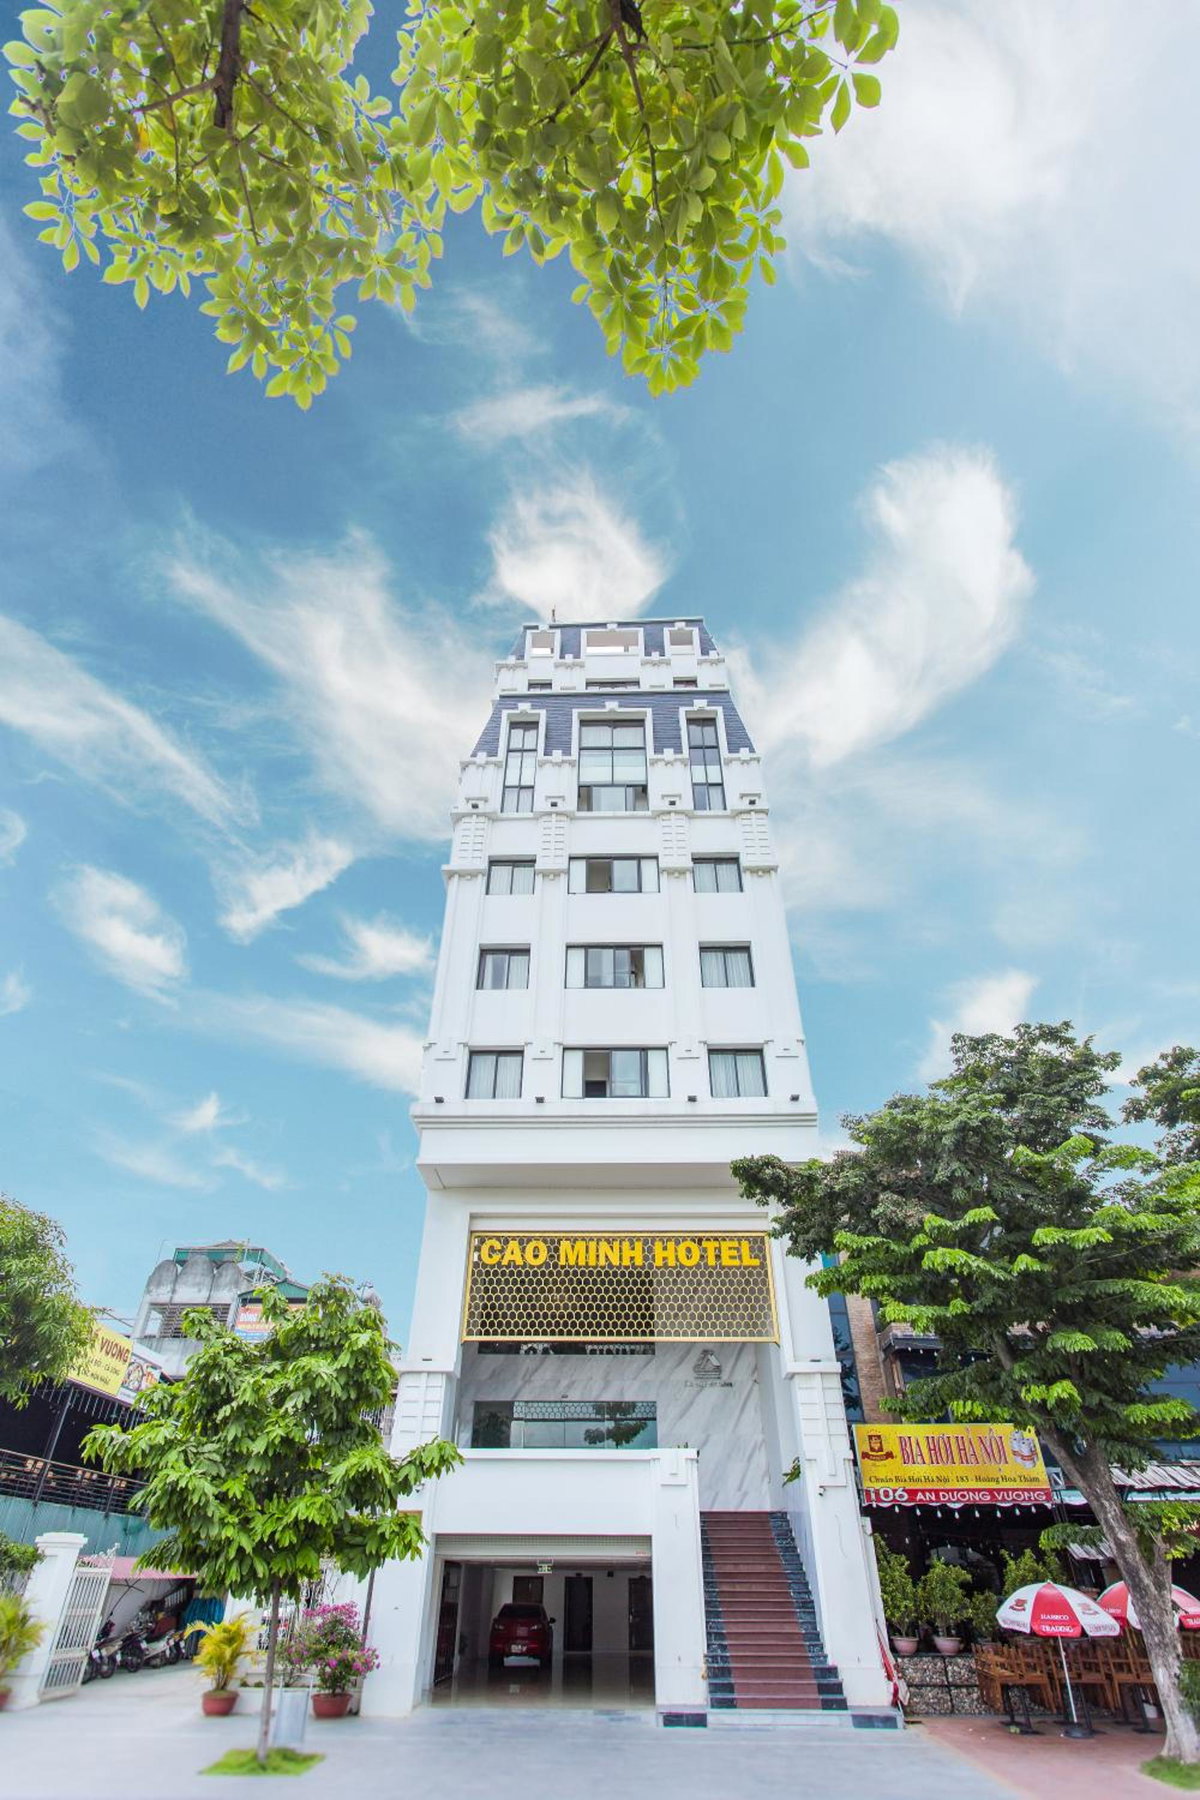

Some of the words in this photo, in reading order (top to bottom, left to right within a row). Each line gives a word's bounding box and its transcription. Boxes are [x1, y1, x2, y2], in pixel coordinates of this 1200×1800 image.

[480, 1239, 548, 1266] CAO
[560, 1240, 643, 1266] MINH
[654, 1240, 760, 1267] HOTEL
[898, 1435, 927, 1465] BIA
[865, 1487, 909, 1502] 106
[916, 1491, 936, 1501] AN
